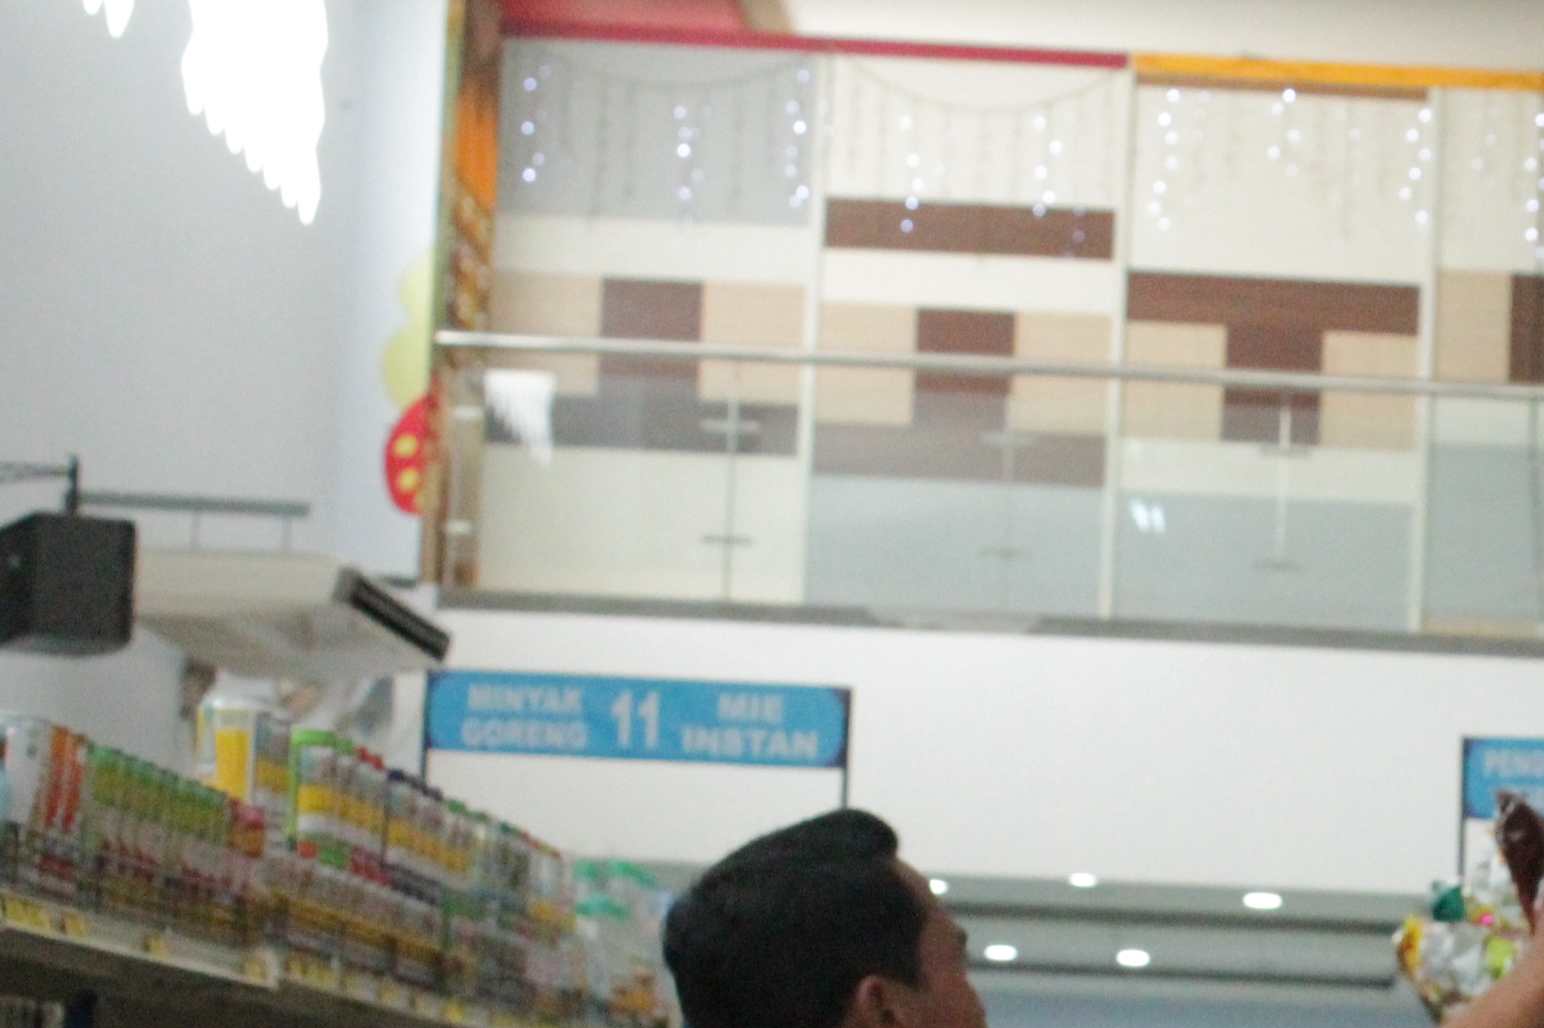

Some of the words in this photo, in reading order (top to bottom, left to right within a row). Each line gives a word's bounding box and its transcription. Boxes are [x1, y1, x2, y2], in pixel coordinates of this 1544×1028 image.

[611, 689, 661, 751] 11
[717, 693, 784, 722] MIE
[681, 726, 820, 759] INSTAN
